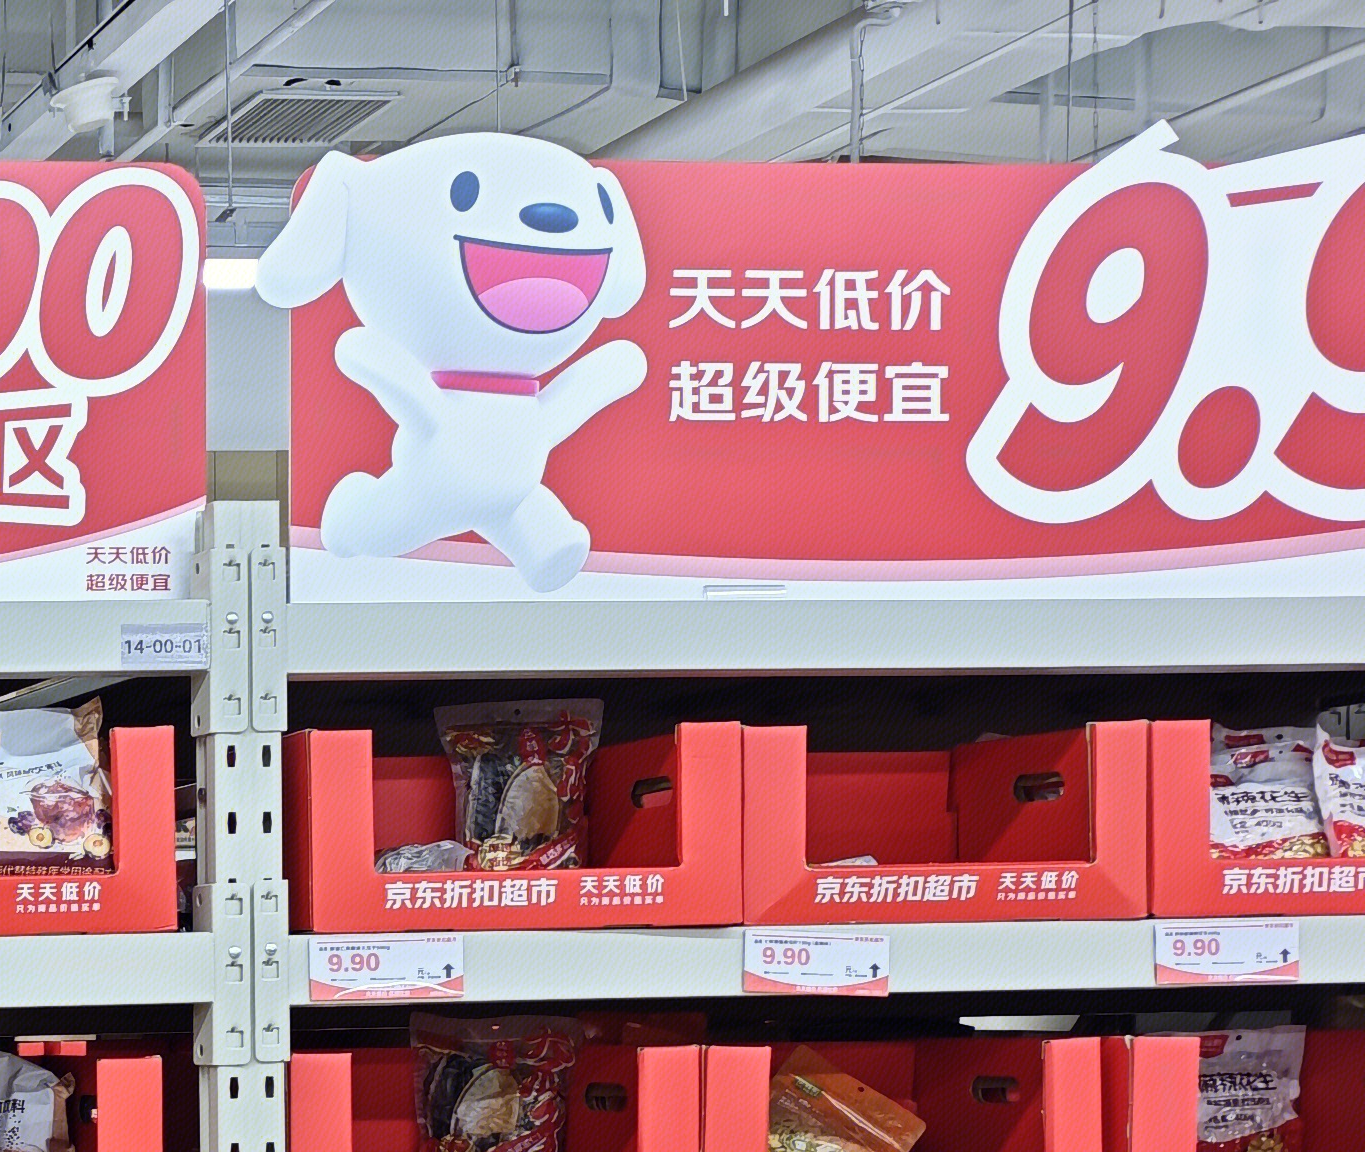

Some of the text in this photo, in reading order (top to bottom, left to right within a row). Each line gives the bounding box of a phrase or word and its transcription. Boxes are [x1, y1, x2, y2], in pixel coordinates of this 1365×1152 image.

[669, 269, 951, 331] 天天低价
[669, 362, 950, 423] 超级便宜
[85, 546, 171, 566] 天天低价
[85, 573, 171, 593] 超级便宜
[124, 638, 203, 655] 14-00-01
[580, 875, 664, 894] 天天低价
[815, 874, 978, 903] 京东折扣超市
[998, 871, 1078, 889] 天天低价
[17, 882, 101, 901] 天天低价
[385, 879, 558, 909] 京东折扣超市
[762, 948, 810, 966] 9.90
[1172, 939, 1220, 957] 9.90
[328, 953, 381, 972] 9.90
